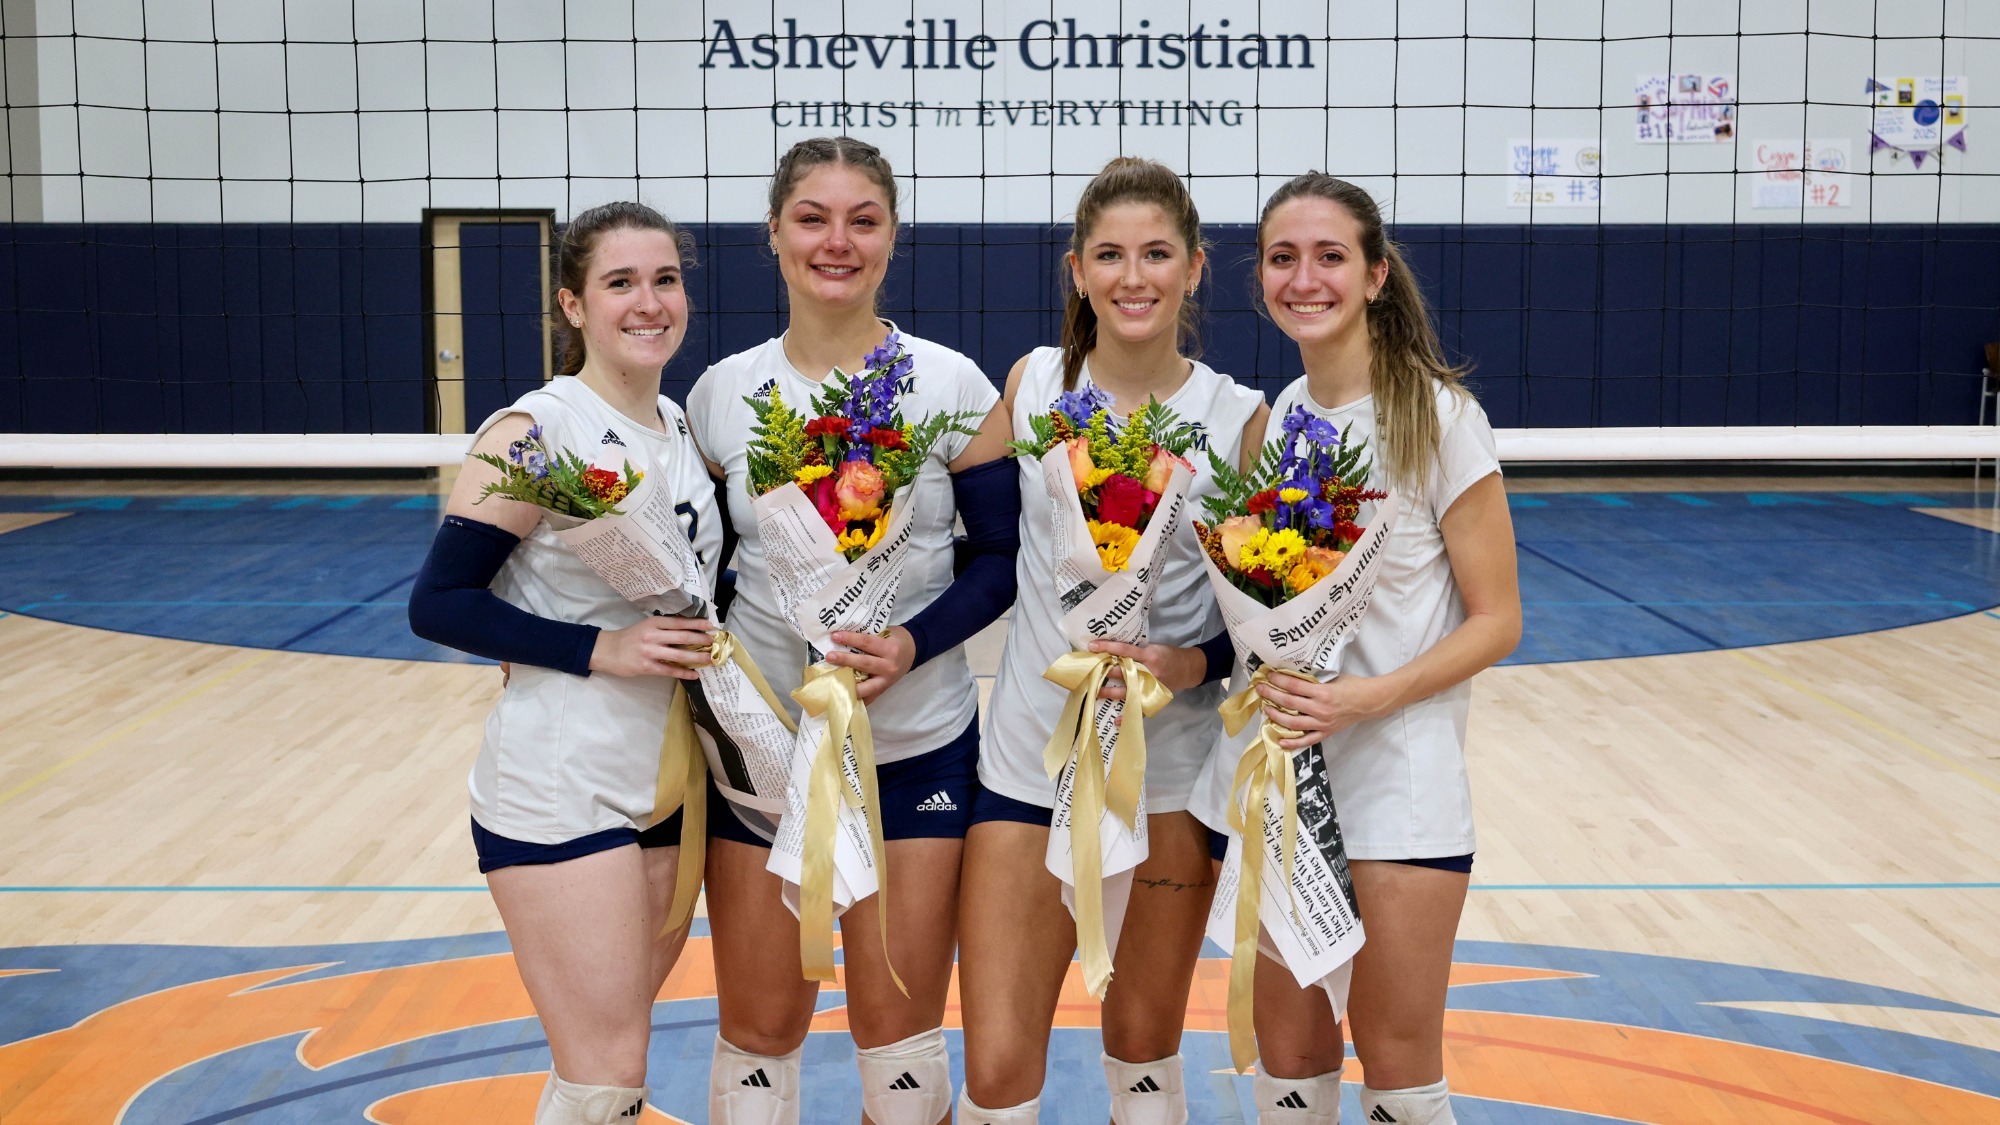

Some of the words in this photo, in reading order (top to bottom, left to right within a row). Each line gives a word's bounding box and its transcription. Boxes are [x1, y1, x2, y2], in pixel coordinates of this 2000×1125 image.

[699, 18, 998, 70] Asheville
[1018, 18, 1315, 71] Christian
[771, 101, 923, 128] CHRIST
[935, 103, 963, 128] in
[975, 100, 1244, 127] EVERYTHING
[1567, 179, 1600, 202] #3
[1811, 183, 1840, 206] #2
[876, 588, 890, 607] COME
[888, 579, 896, 590] TO
[894, 574, 900, 582] A
[1268, 602, 1327, 650] Senior
[1329, 521, 1389, 607] Spotlight
[818, 571, 867, 630] Senior
[1086, 586, 1142, 637] Senior
[1351, 604, 1357, 612] A
[873, 605, 890, 634] OVE
[1315, 634, 1339, 670] LOVE
[1336, 610, 1359, 637] OUR
[916, 802, 958, 811] adidas
[1055, 801, 1071, 830] Every
[848, 822, 864, 850] Spotlight
[1275, 824, 1283, 838] in
[1305, 874, 1315, 888] Is
[1310, 856, 1323, 882] They
[1312, 886, 1333, 914] Leave
[1323, 879, 1354, 935] Teammate
[1311, 912, 1337, 948] Untold
[1329, 913, 1346, 942] They
